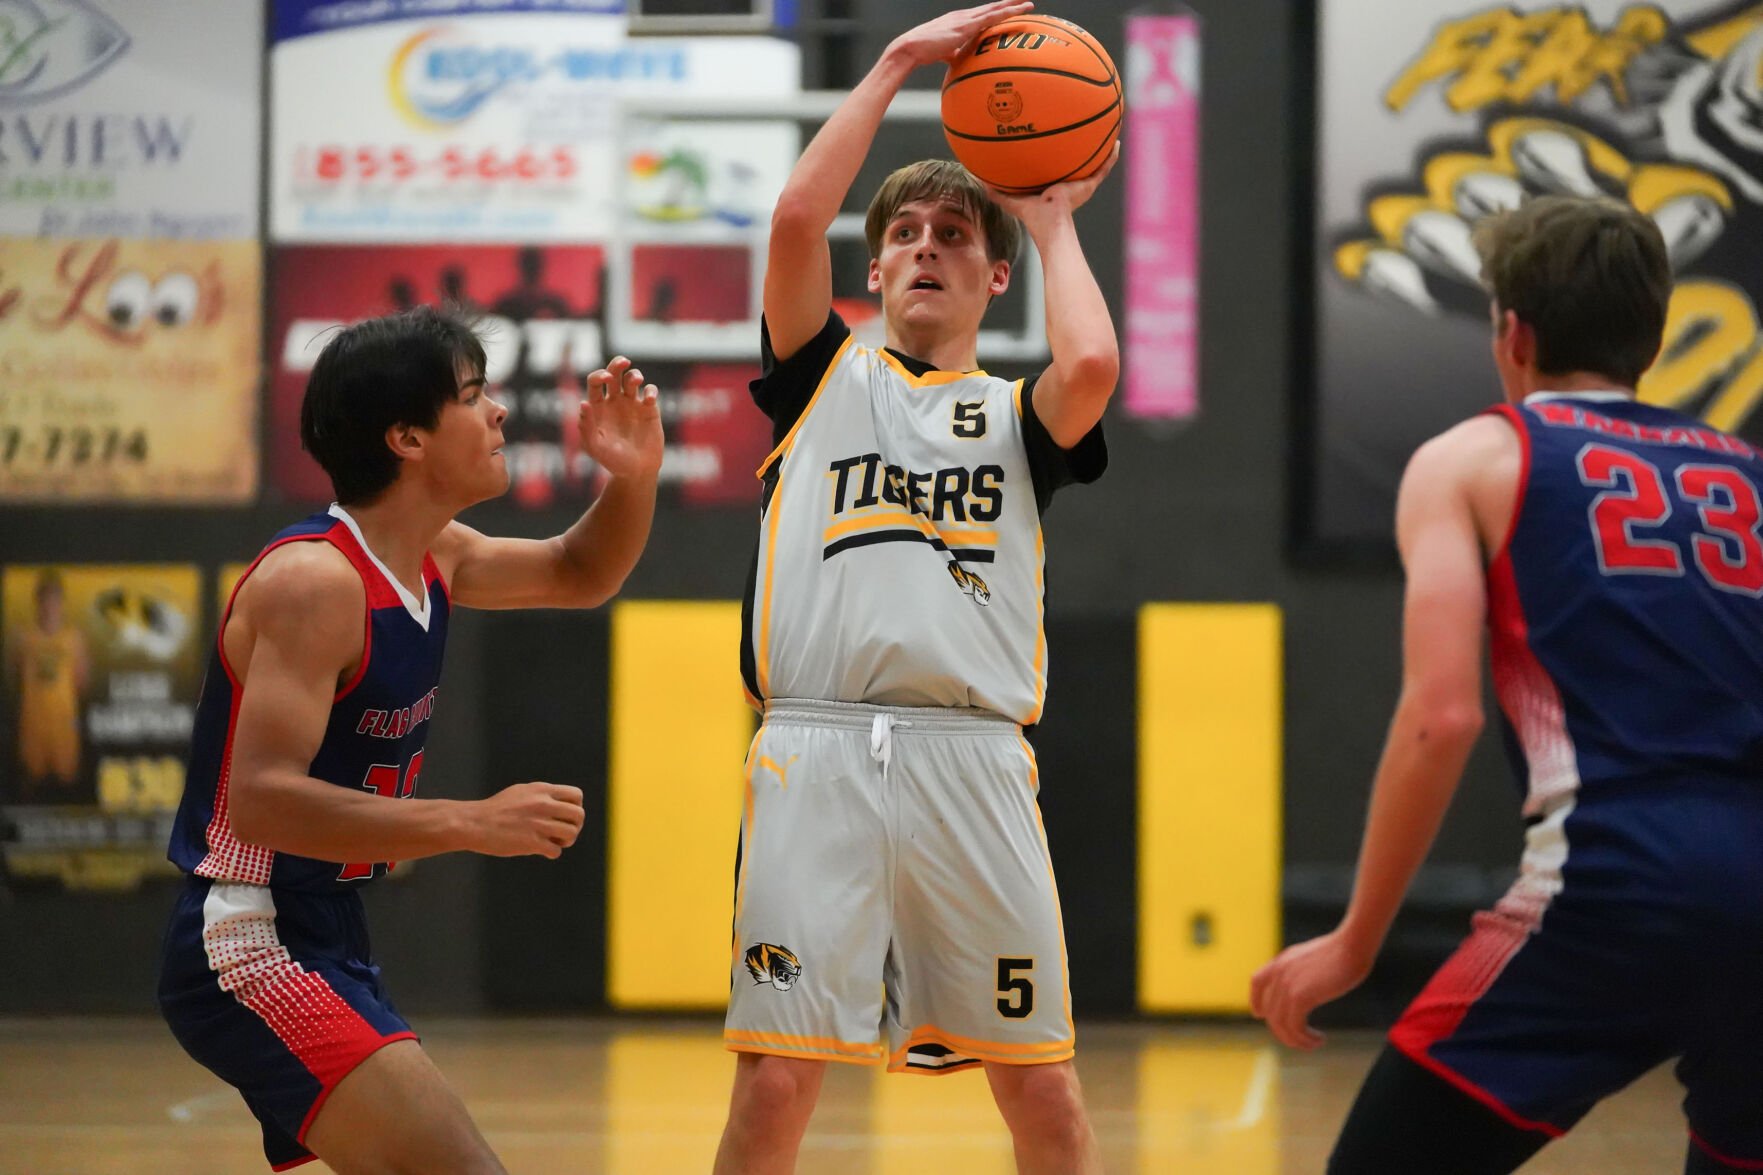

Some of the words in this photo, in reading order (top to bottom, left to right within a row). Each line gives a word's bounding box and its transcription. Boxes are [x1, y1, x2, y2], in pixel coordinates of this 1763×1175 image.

[0, 114, 196, 167] VIEW
[996, 123, 1037, 136] GAME
[952, 400, 986, 438] 5
[829, 453, 1005, 522] TIGERS
[1575, 442, 1763, 600] 23
[996, 956, 1034, 1019] 5
